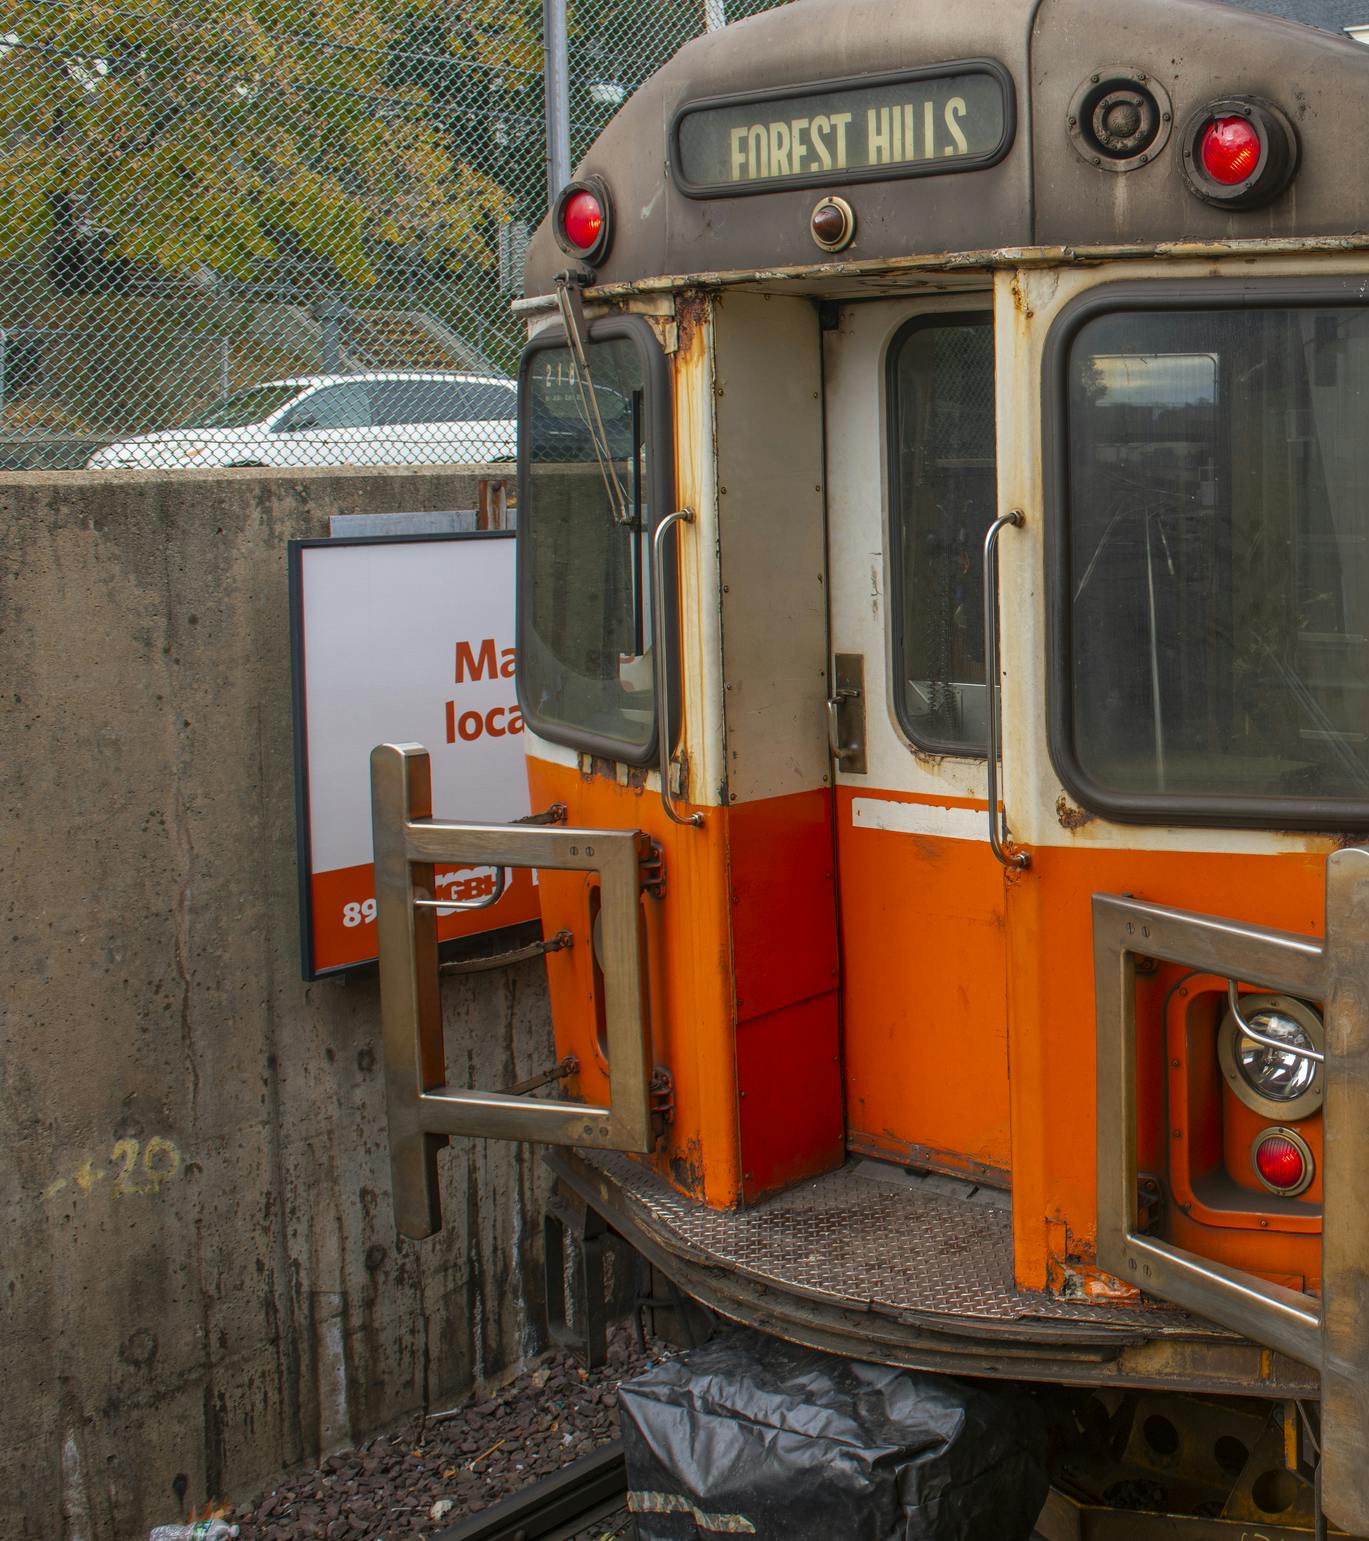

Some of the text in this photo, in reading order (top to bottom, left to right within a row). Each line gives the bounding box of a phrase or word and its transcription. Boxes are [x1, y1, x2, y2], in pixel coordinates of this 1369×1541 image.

[729, 96, 968, 181] FOREST HILLS
[445, 700, 525, 744] loca
